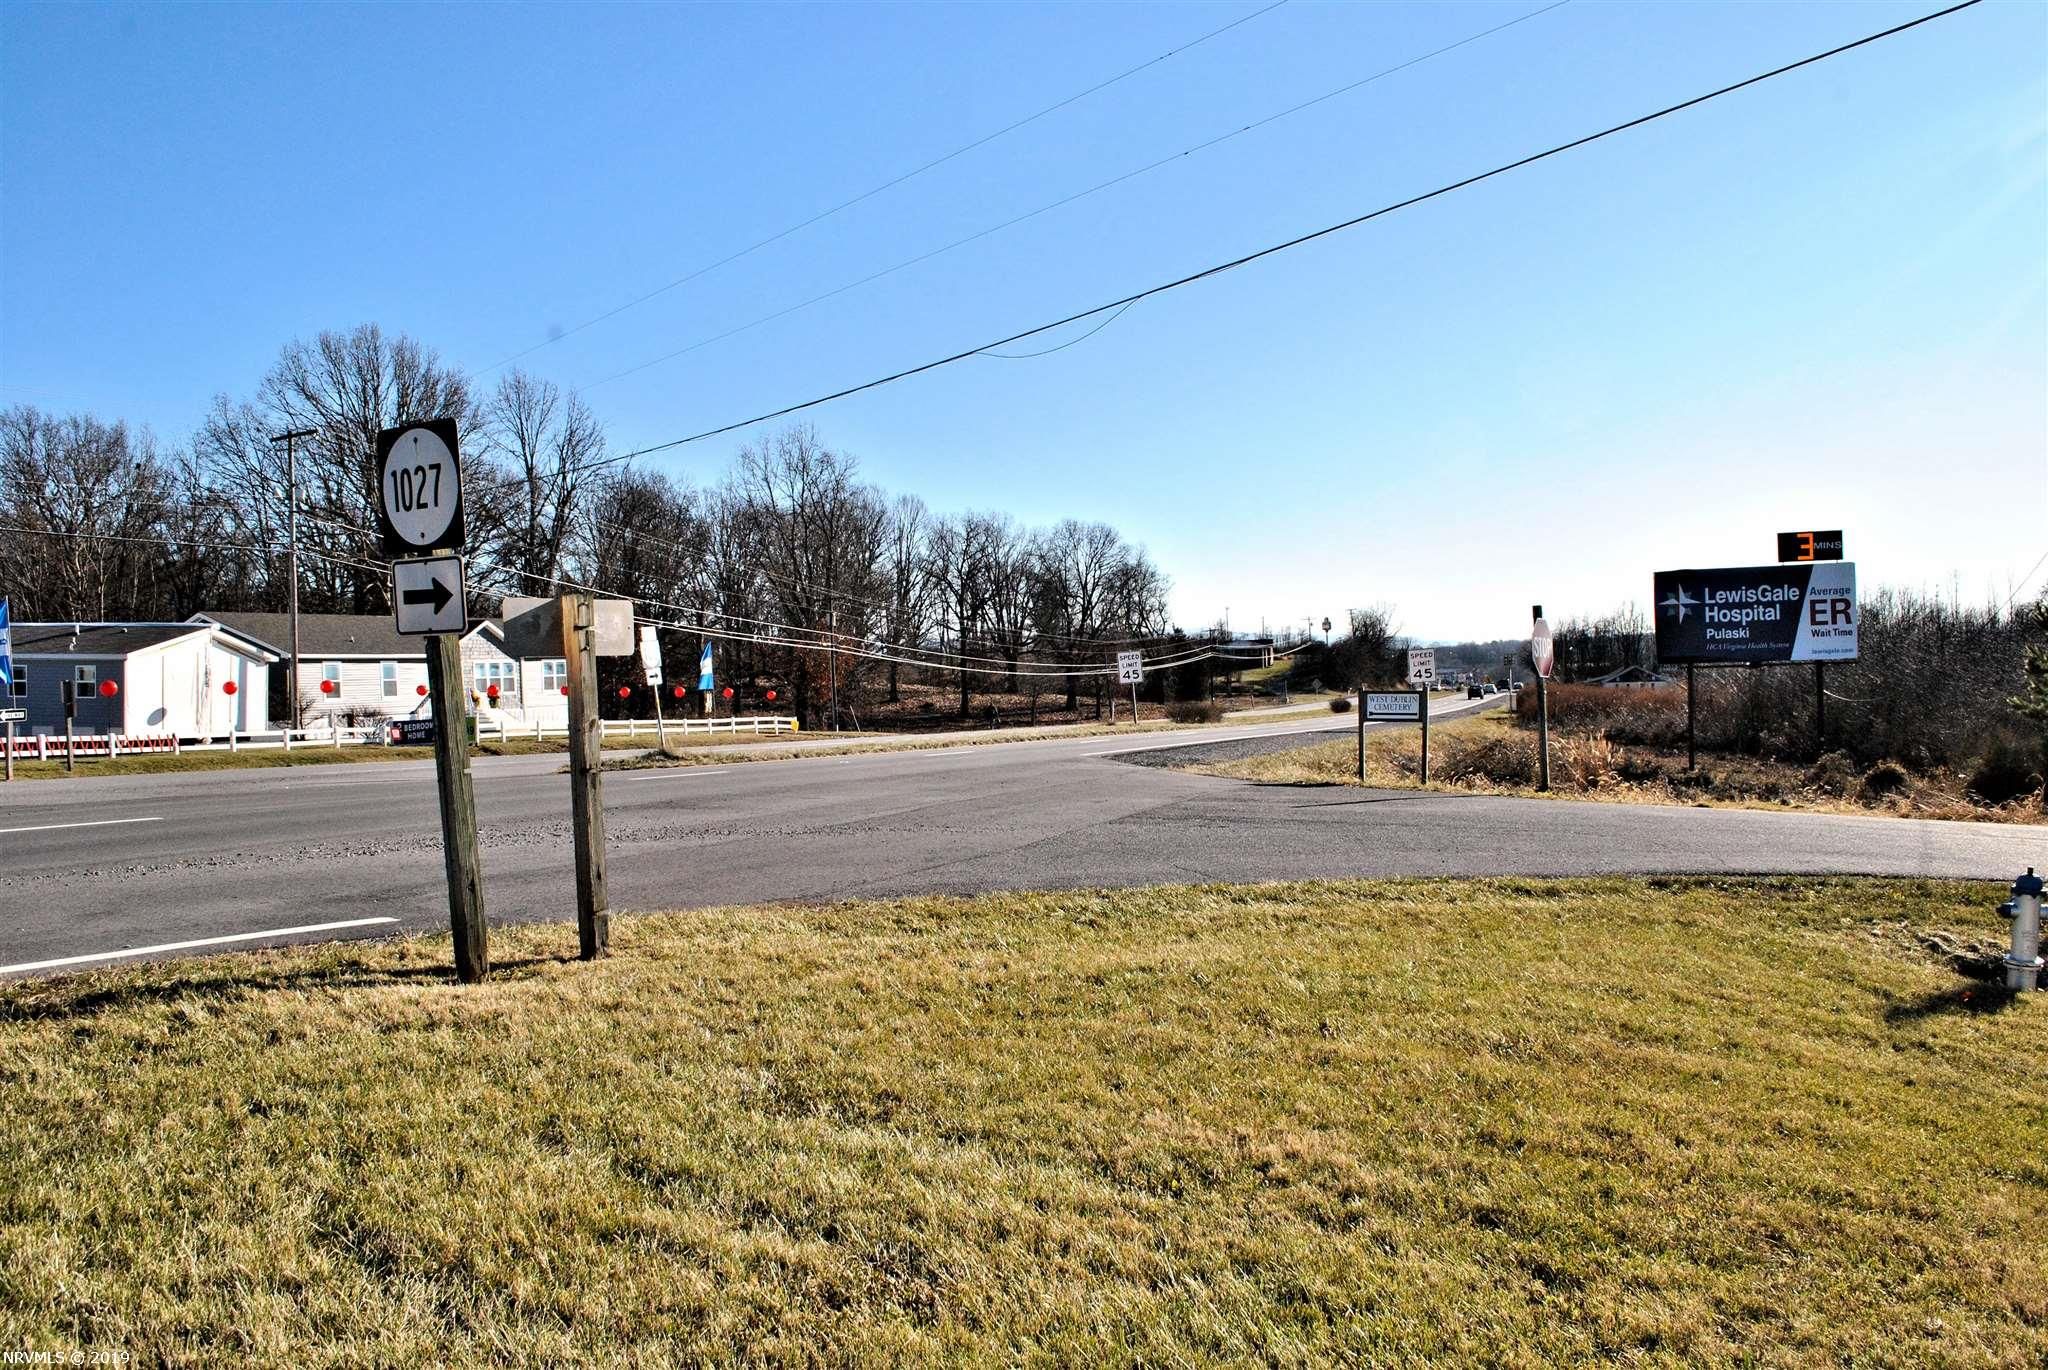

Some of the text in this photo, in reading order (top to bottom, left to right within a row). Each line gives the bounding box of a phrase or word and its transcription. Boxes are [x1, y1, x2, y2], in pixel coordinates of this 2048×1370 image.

[391, 463, 442, 513] 1027
[1796, 532, 1814, 561] 3
[1813, 541, 1842, 550] MINS
[1704, 584, 1800, 604] LewisGale
[1809, 586, 1851, 597] Average
[1705, 603, 1781, 626] Hospital
[1809, 598, 1853, 626] ER
[1706, 627, 1750, 640] Pulaski
[1811, 627, 1854, 638] Wait Time
[1533, 636, 1552, 658] STOP
[1410, 652, 1433, 660] SPEED
[1412, 660, 1431, 668] LIMIT
[1122, 670, 1140, 680] 45
[1413, 667, 1433, 679] 45
[1368, 695, 1418, 704] WEST DUBLIN
[1374, 703, 1413, 712] CEMETERY
[407, 731, 426, 740] HOME
